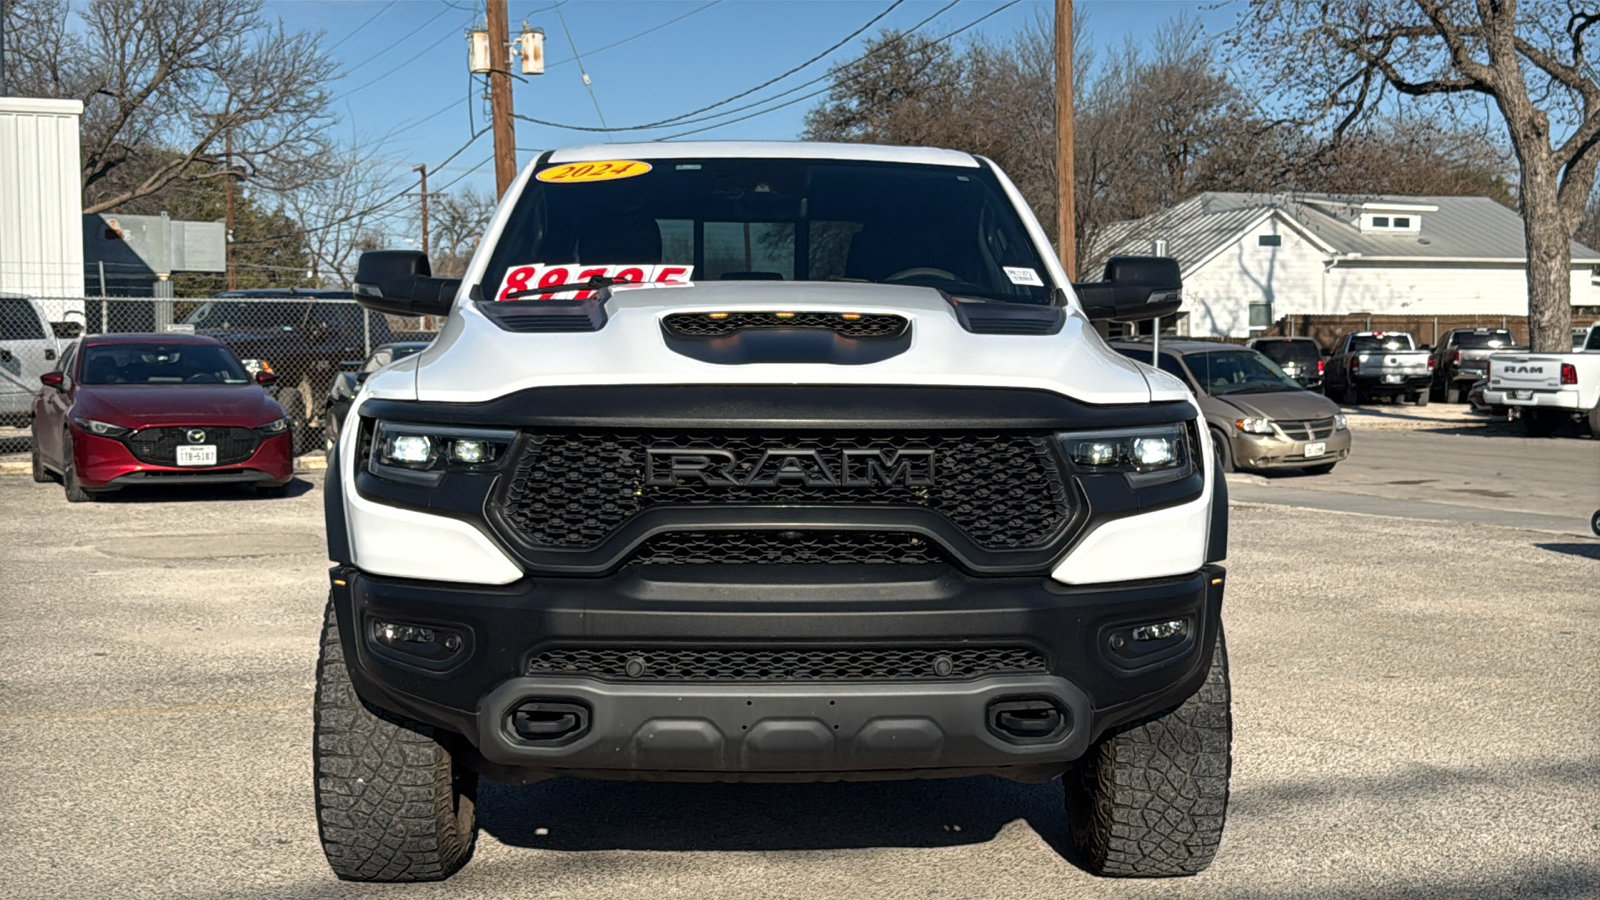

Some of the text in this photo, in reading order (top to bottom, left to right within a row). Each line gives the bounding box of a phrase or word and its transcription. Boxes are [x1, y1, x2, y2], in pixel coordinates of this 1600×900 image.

[551, 163, 635, 180] 2024
[1504, 366, 1543, 374] RAM
[645, 448, 935, 487] RAM
